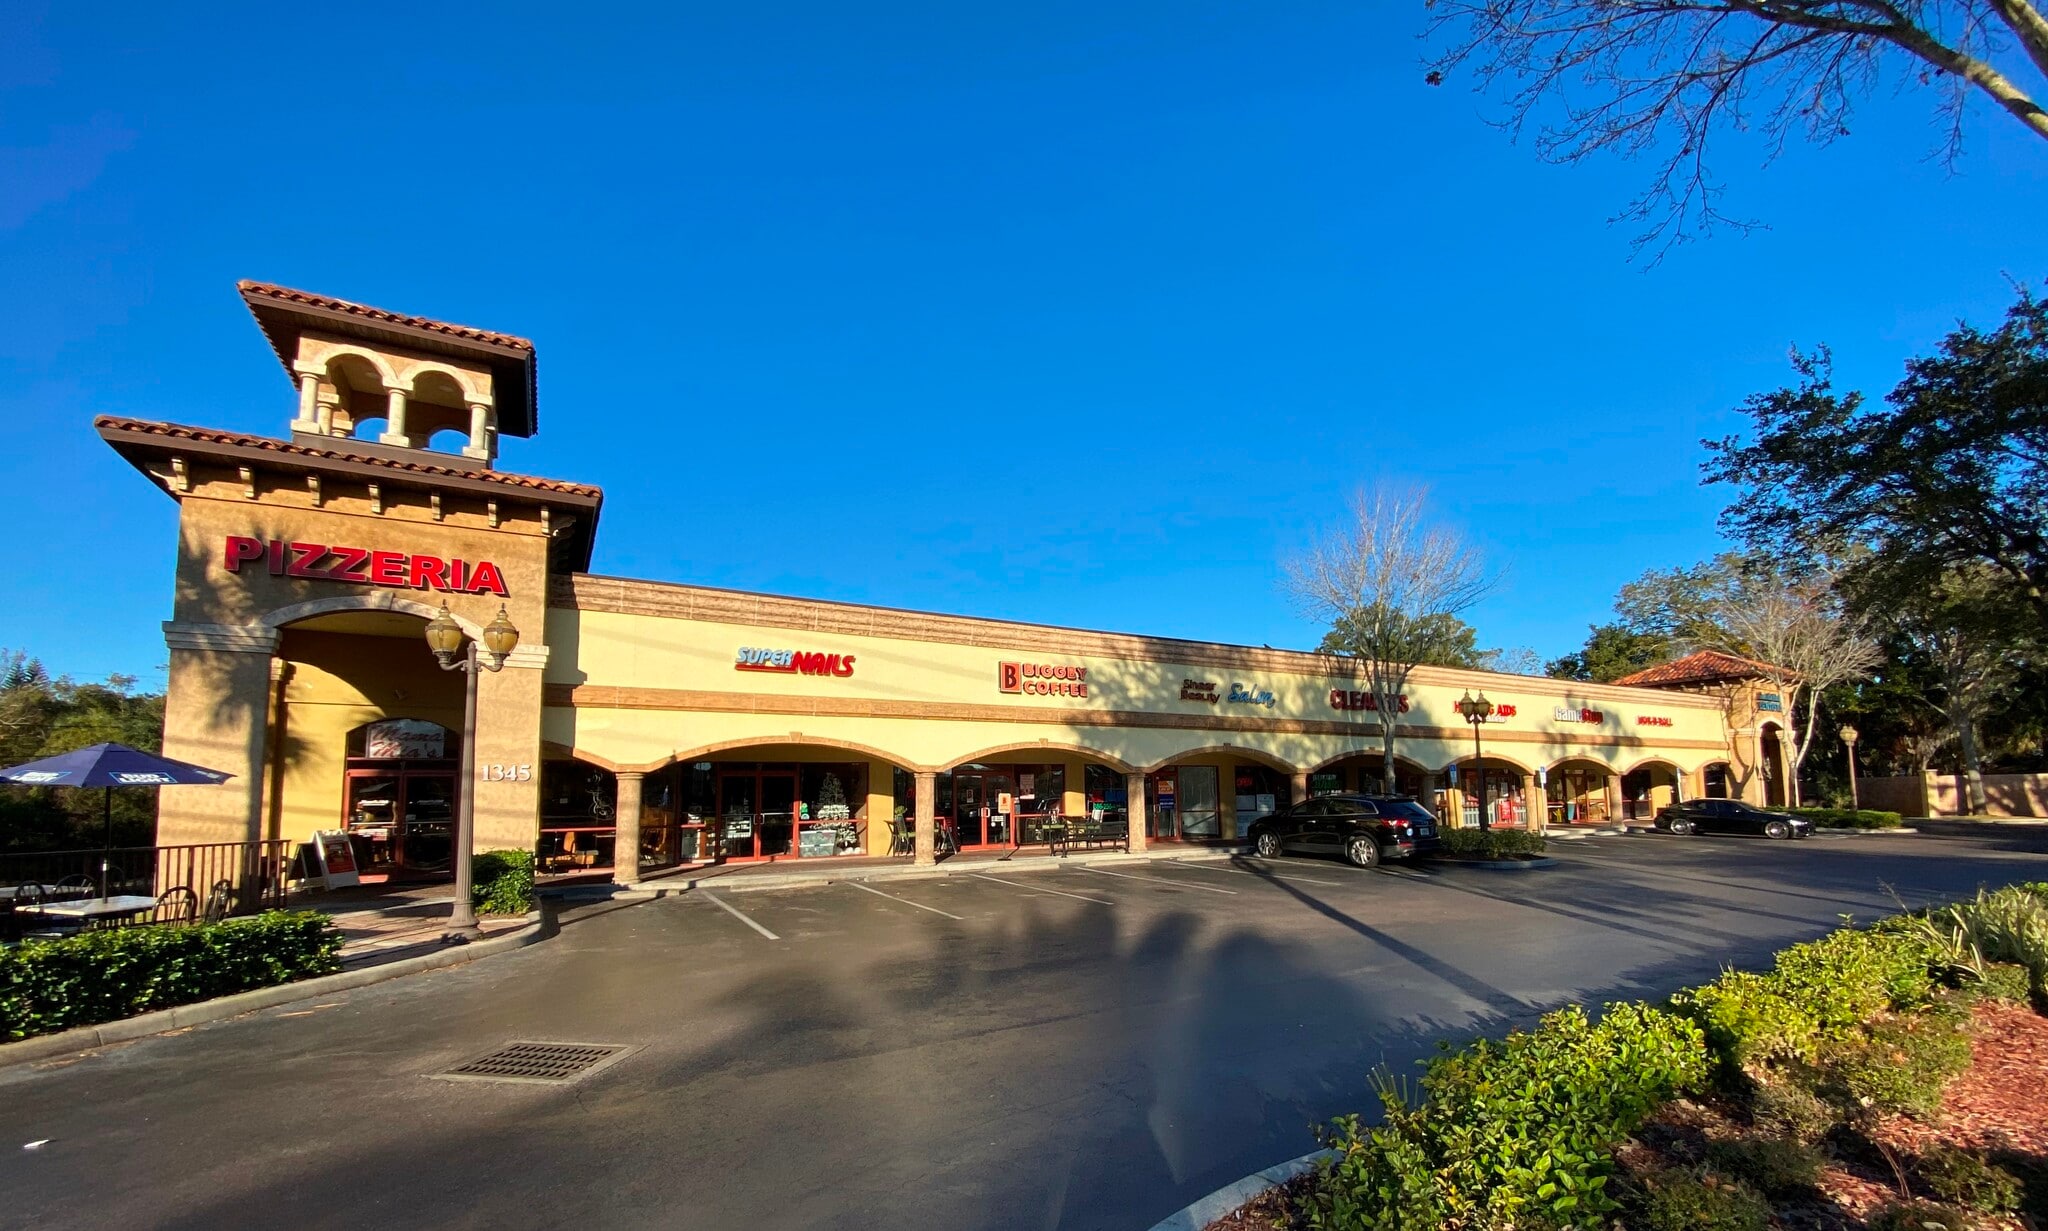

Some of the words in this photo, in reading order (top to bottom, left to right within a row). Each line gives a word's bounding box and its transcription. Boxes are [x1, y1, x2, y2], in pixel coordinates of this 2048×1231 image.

[224, 535, 508, 597] PIZZERIA
[736, 647, 793, 666] SUPER
[790, 651, 856, 677] NAILS
[1004, 664, 1017, 689] B
[1023, 663, 1087, 681] BIGGBY
[1023, 680, 1088, 698] COFFEE
[1180, 689, 1220, 703] Beauty
[1496, 704, 1516, 717] AIDS
[481, 763, 532, 782] 1345
